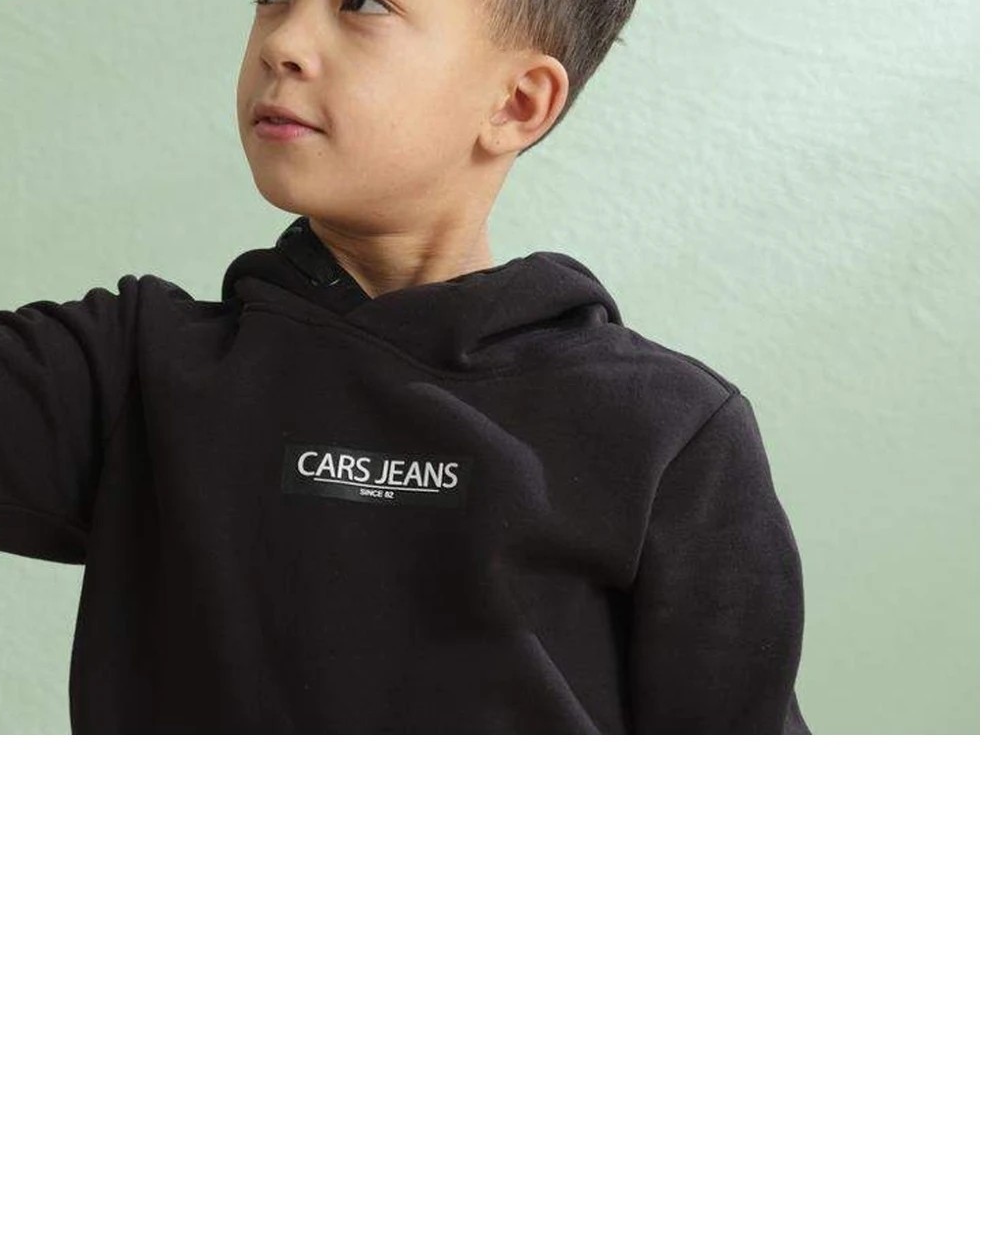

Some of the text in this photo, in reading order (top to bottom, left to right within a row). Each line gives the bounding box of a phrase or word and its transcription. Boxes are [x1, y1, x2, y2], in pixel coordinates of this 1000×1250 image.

[298, 451, 458, 489] CARS JEANS
[359, 488, 383, 498] SINCE
